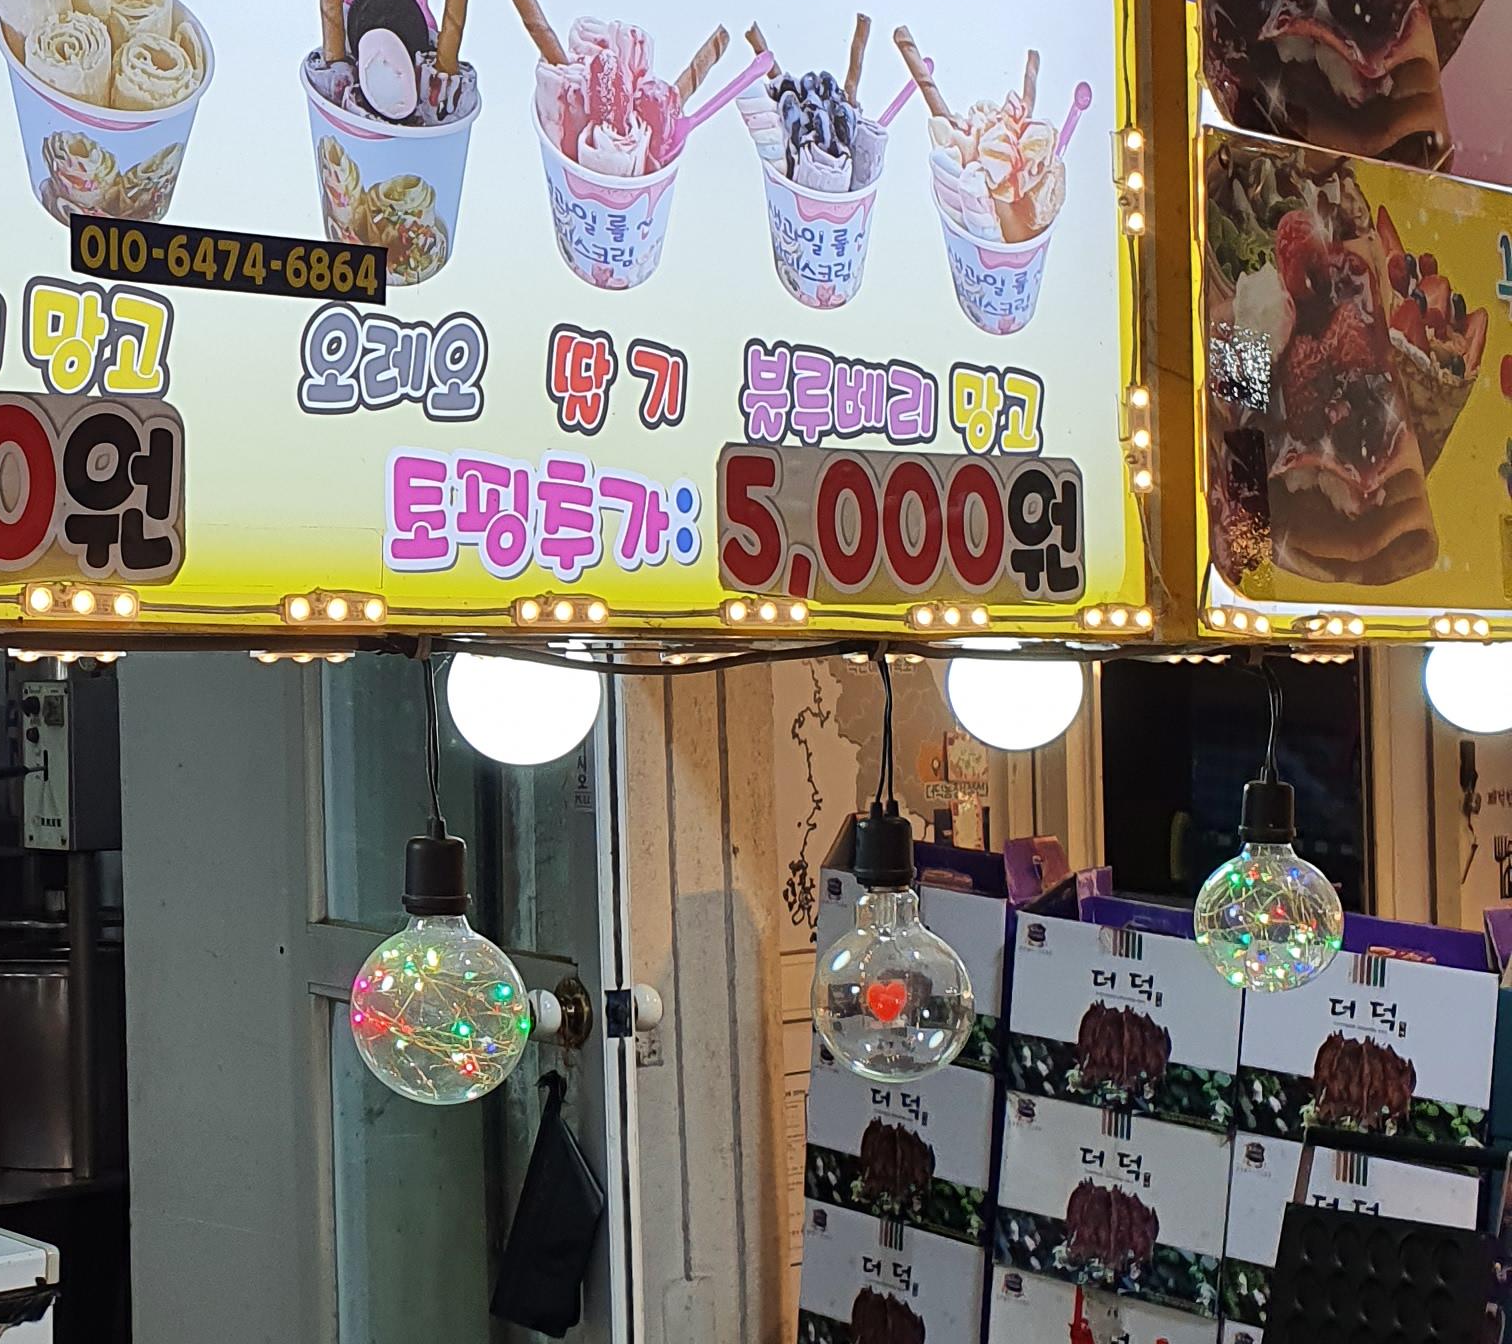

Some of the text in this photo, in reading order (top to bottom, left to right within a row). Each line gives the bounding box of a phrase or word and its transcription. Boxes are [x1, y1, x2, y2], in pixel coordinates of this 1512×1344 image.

[78, 223, 380, 297] 010-6474-6864
[25, 277, 174, 396] 망고
[300, 304, 487, 420] 오레오
[741, 339, 938, 444] 블루베리
[948, 365, 1044, 454] 망고
[385, 446, 1085, 599] 토핑추가: 5,000원
[1091, 968, 1155, 1002] 더덕
[1329, 997, 1398, 1032] 더덕
[1079, 1146, 1143, 1181] 더덕
